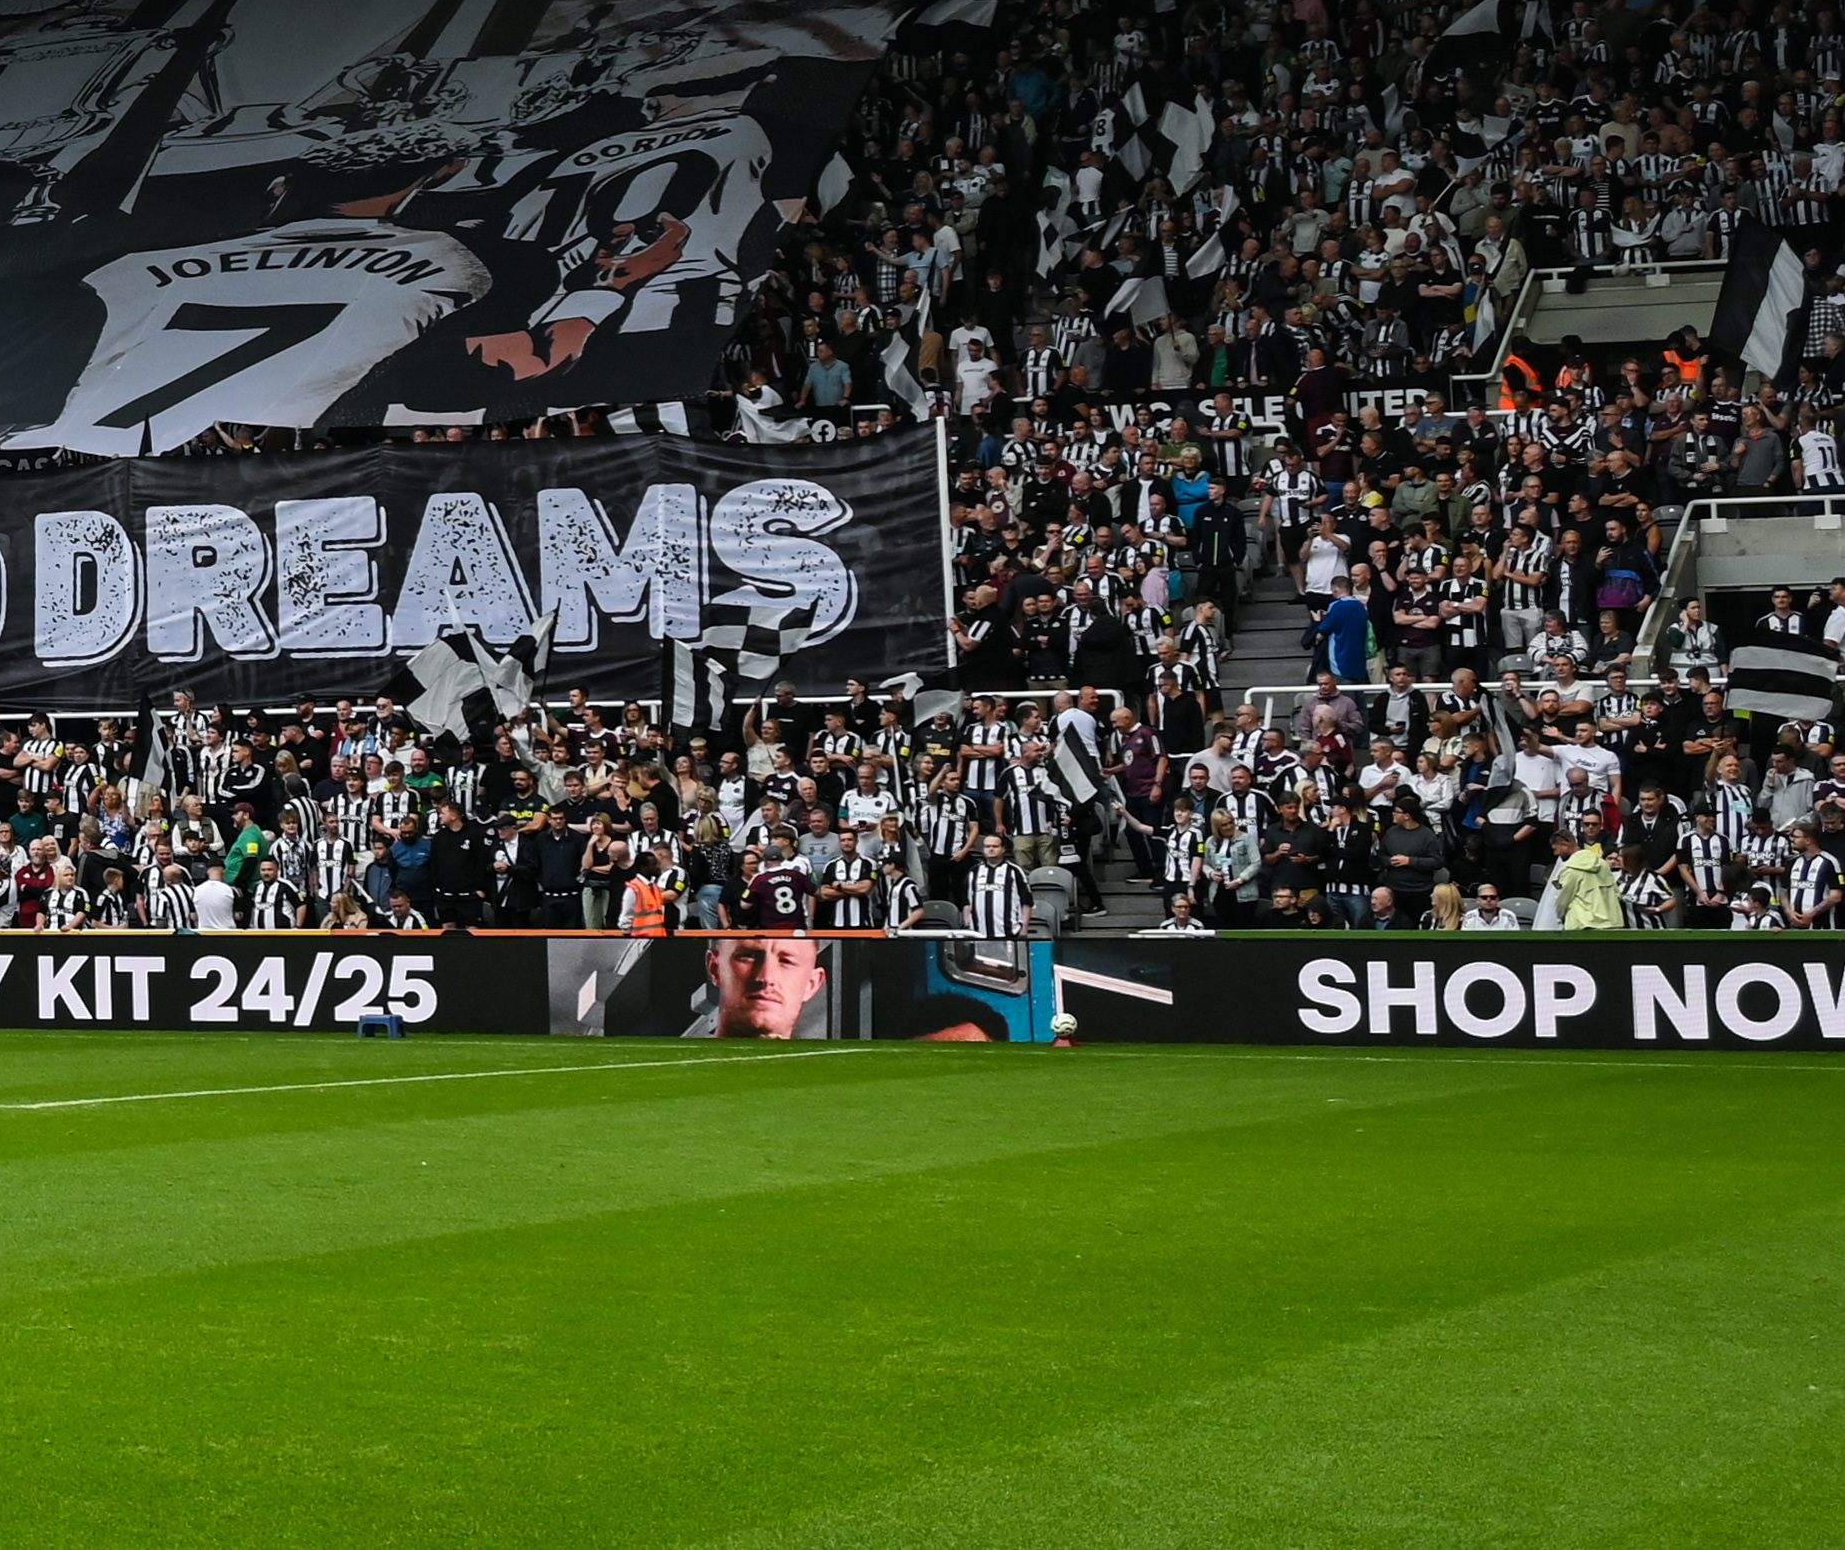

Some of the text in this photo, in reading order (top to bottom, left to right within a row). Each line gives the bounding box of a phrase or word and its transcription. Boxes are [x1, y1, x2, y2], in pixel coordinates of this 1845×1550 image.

[573, 126, 732, 167] GORDON
[146, 246, 445, 287] JOELINTON
[92, 302, 348, 429] 7
[1818, 446, 1836, 470] 11
[35, 477, 858, 668] DREAMS
[774, 885, 798, 915] 8
[37, 954, 165, 1021] KIT
[189, 951, 437, 1027] 24/25
[1297, 957, 1598, 1038] SHOP
